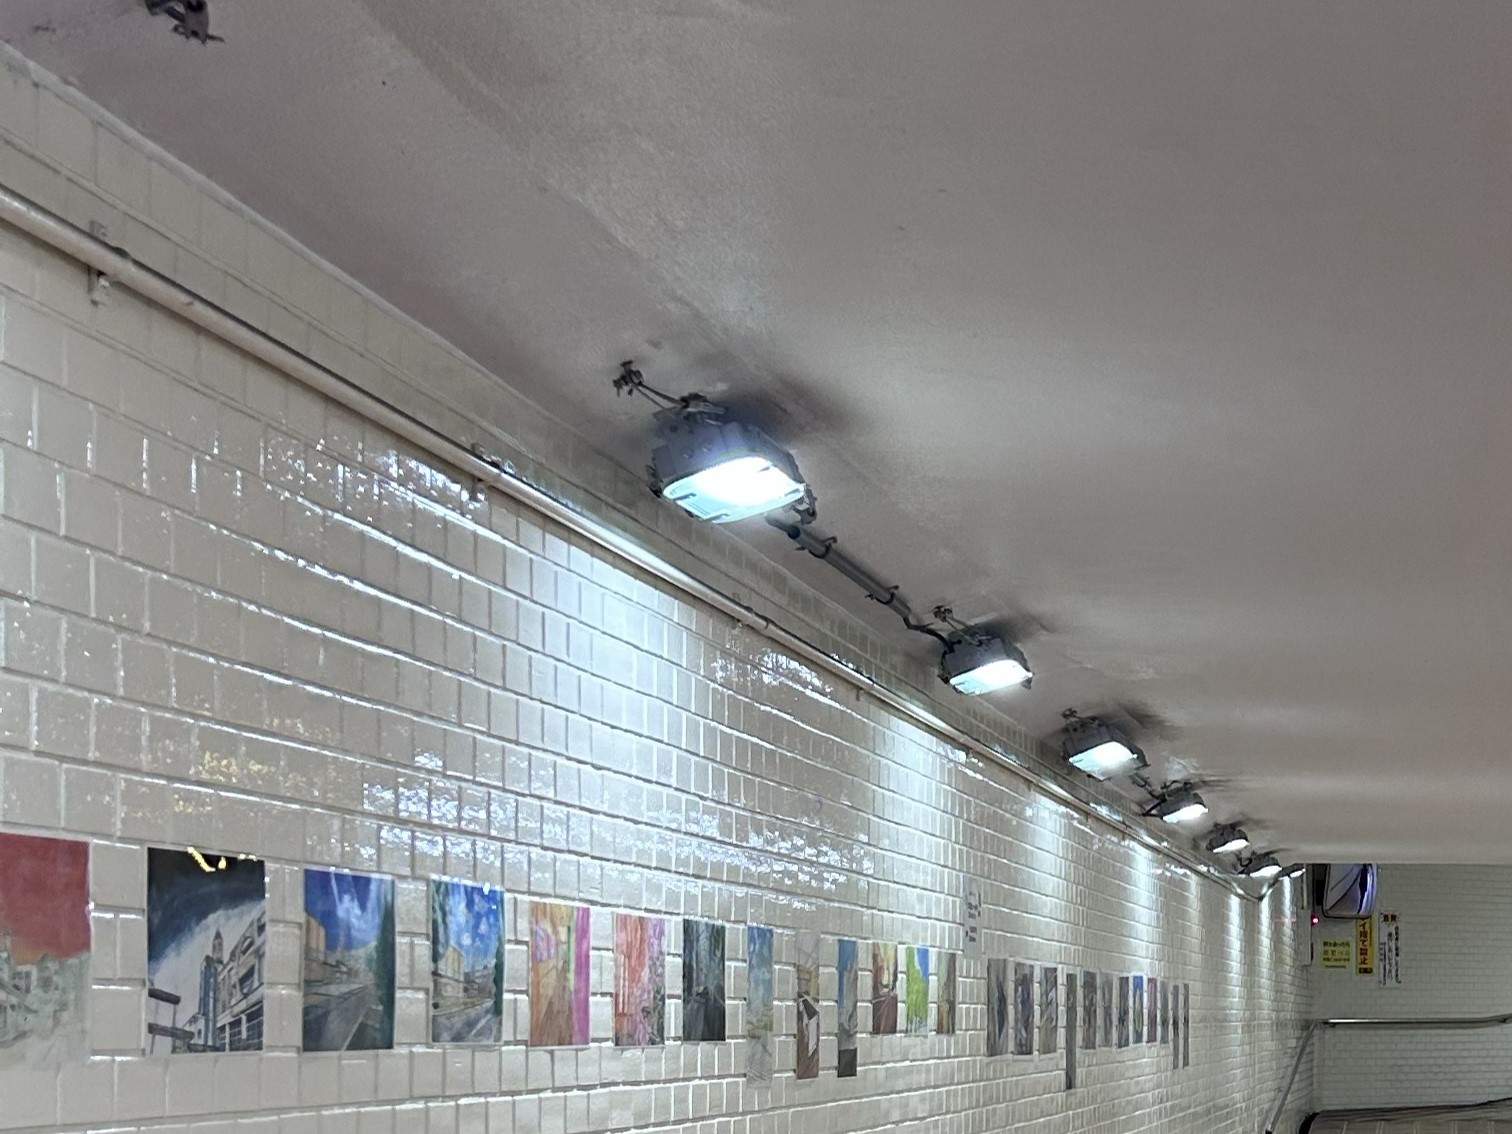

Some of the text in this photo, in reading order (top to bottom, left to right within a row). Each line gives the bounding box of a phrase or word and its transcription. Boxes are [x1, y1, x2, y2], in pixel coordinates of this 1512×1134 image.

[1359, 919, 1368, 965] イ捨て禁止
